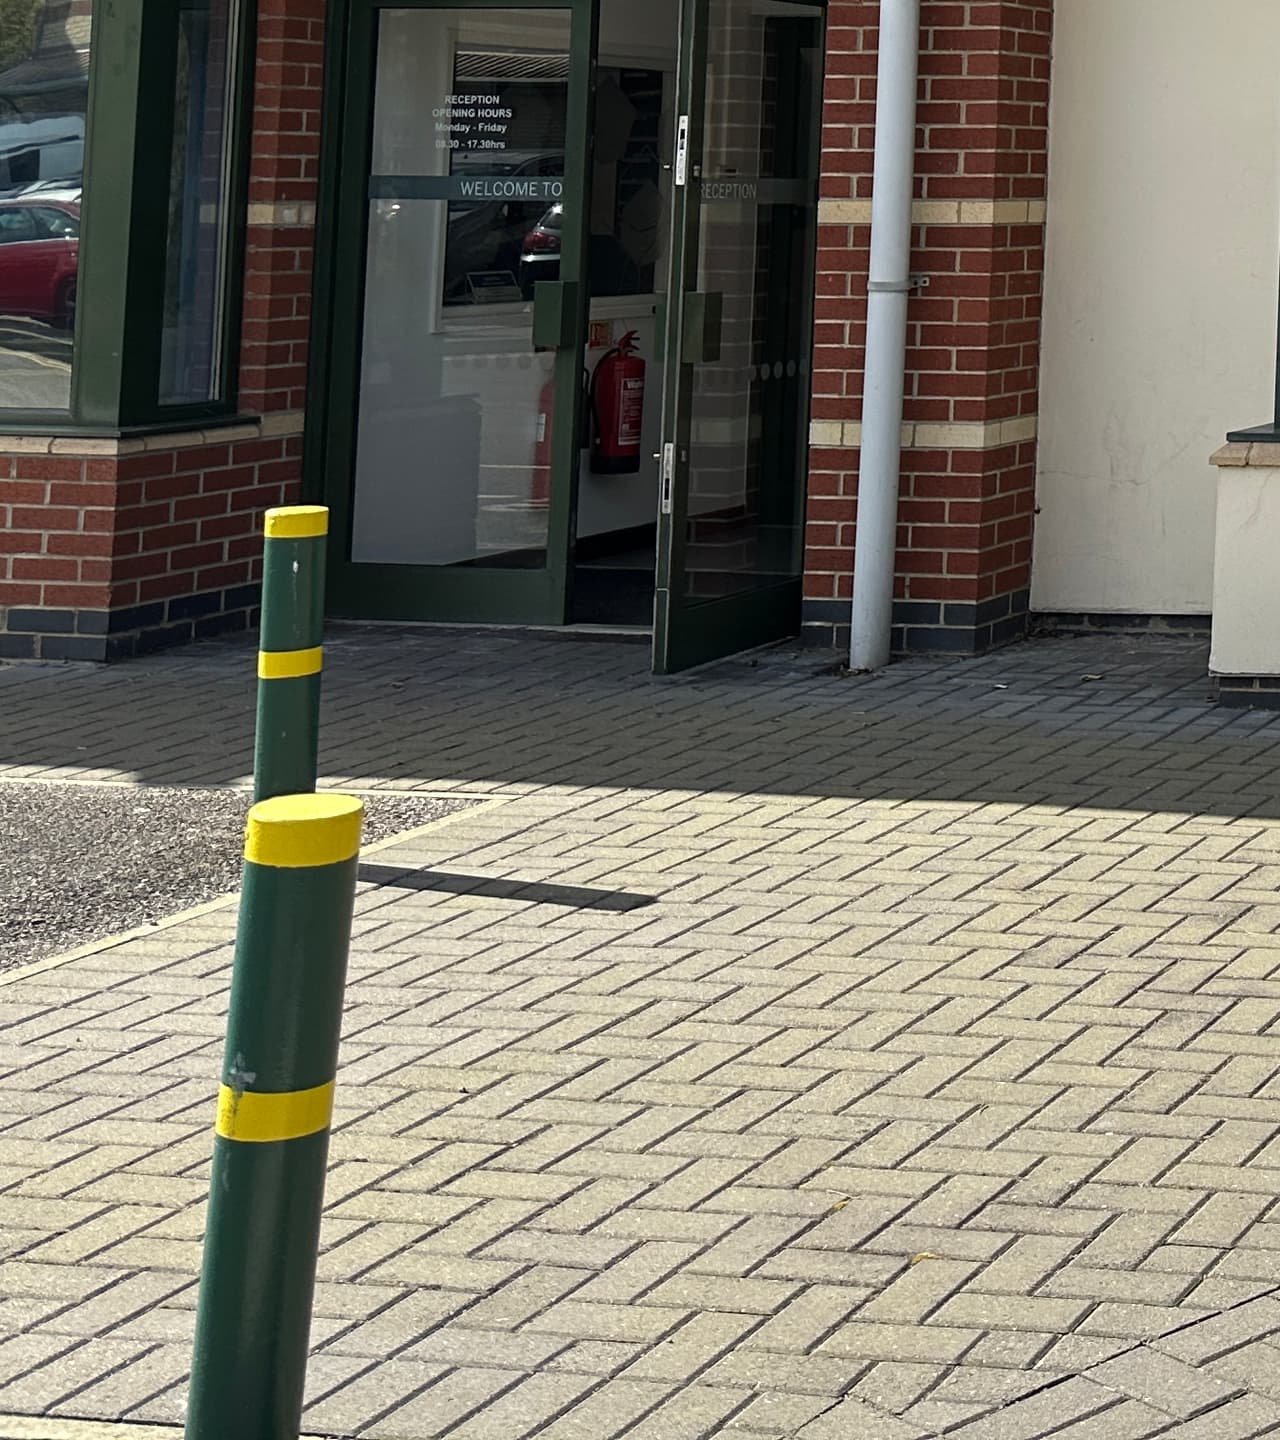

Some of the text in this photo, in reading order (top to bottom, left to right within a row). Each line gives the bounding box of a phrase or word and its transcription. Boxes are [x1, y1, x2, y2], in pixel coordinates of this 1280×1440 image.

[444, 95, 500, 105] RECEPTION
[432, 108, 513, 118] OPENING HOURS
[435, 122, 471, 134] Monday
[478, 122, 508, 134] Friday
[460, 181, 564, 197] WELCOME TO
[700, 183, 758, 200] RECEPTION
